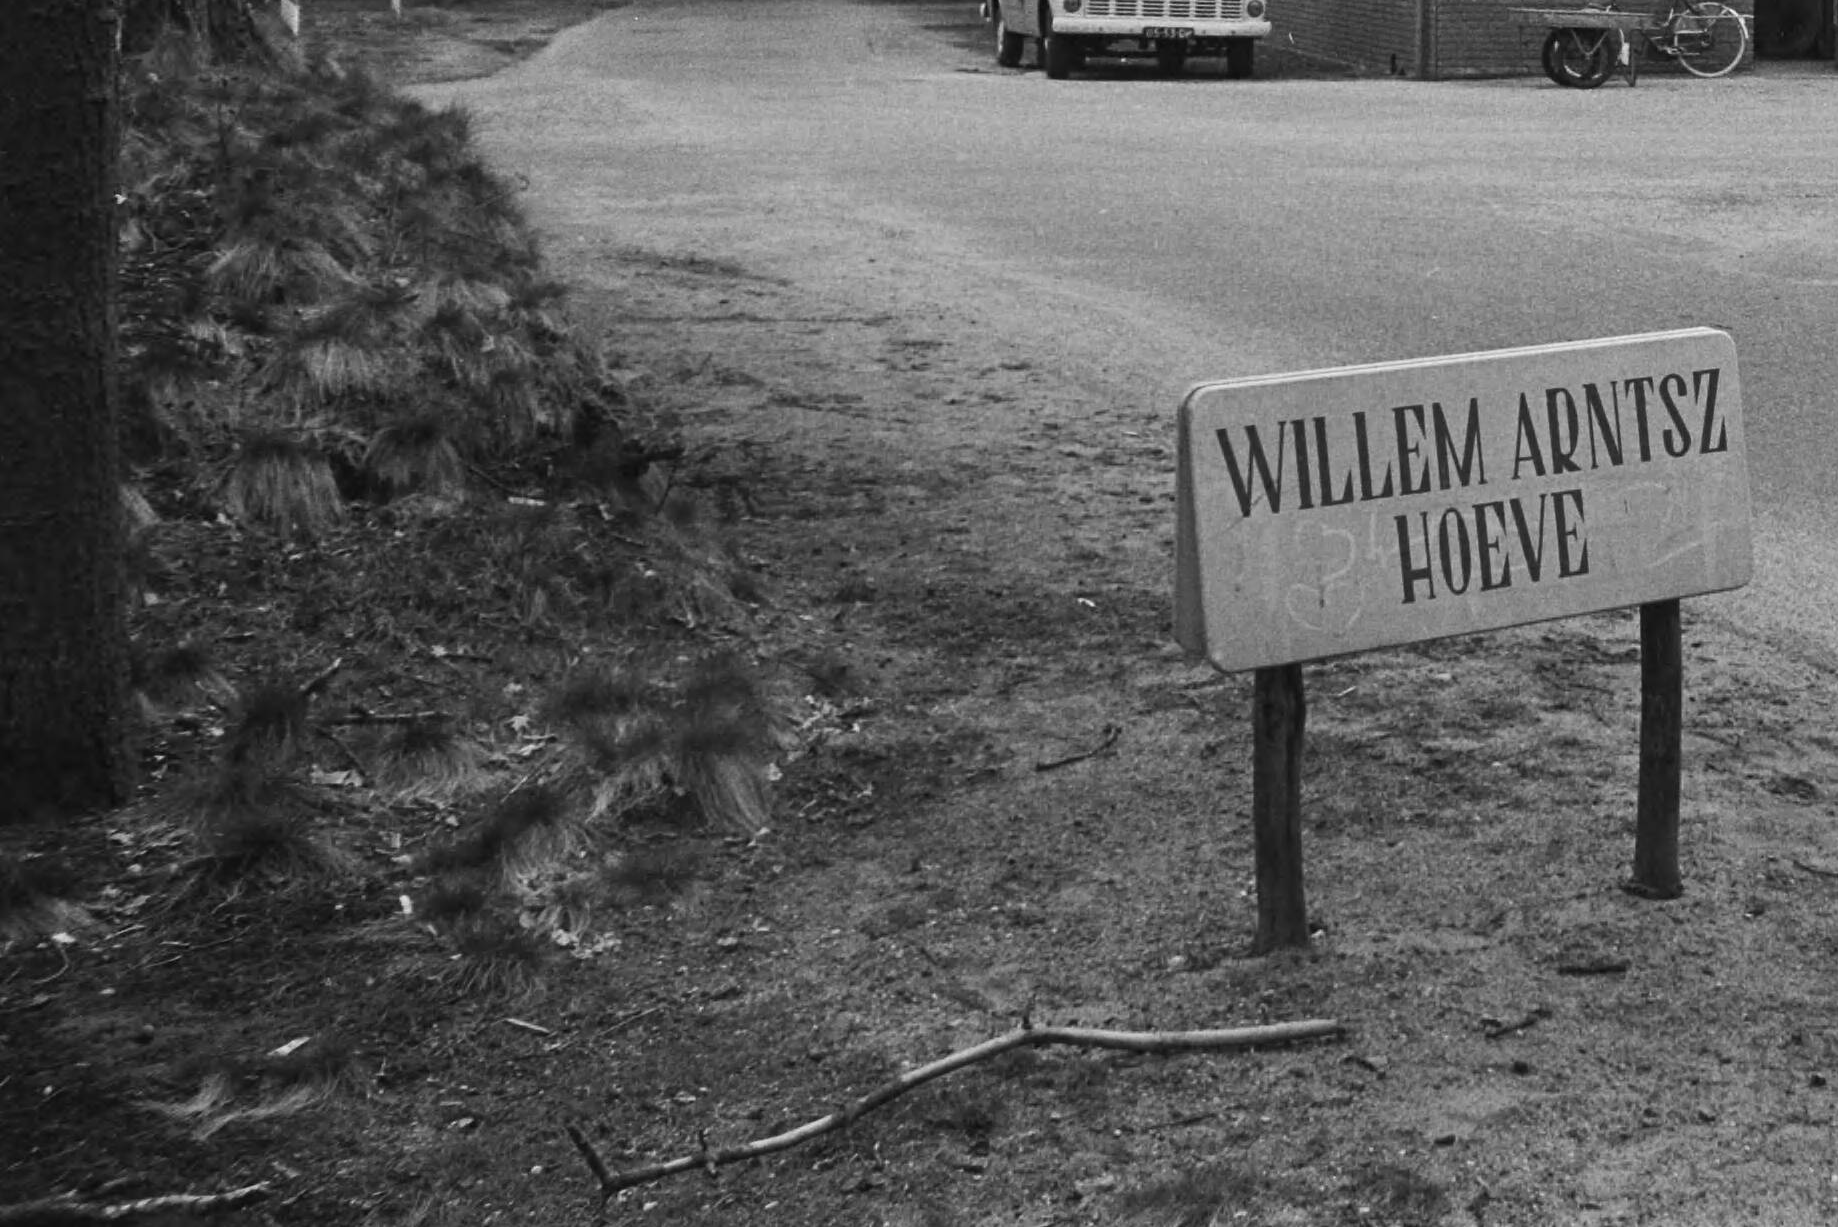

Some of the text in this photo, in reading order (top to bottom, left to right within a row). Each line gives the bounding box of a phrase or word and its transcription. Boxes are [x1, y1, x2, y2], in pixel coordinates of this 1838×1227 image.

[1216, 368, 1728, 518] WILLEM ARNTSZ
[1394, 489, 1590, 604] HOEVE
